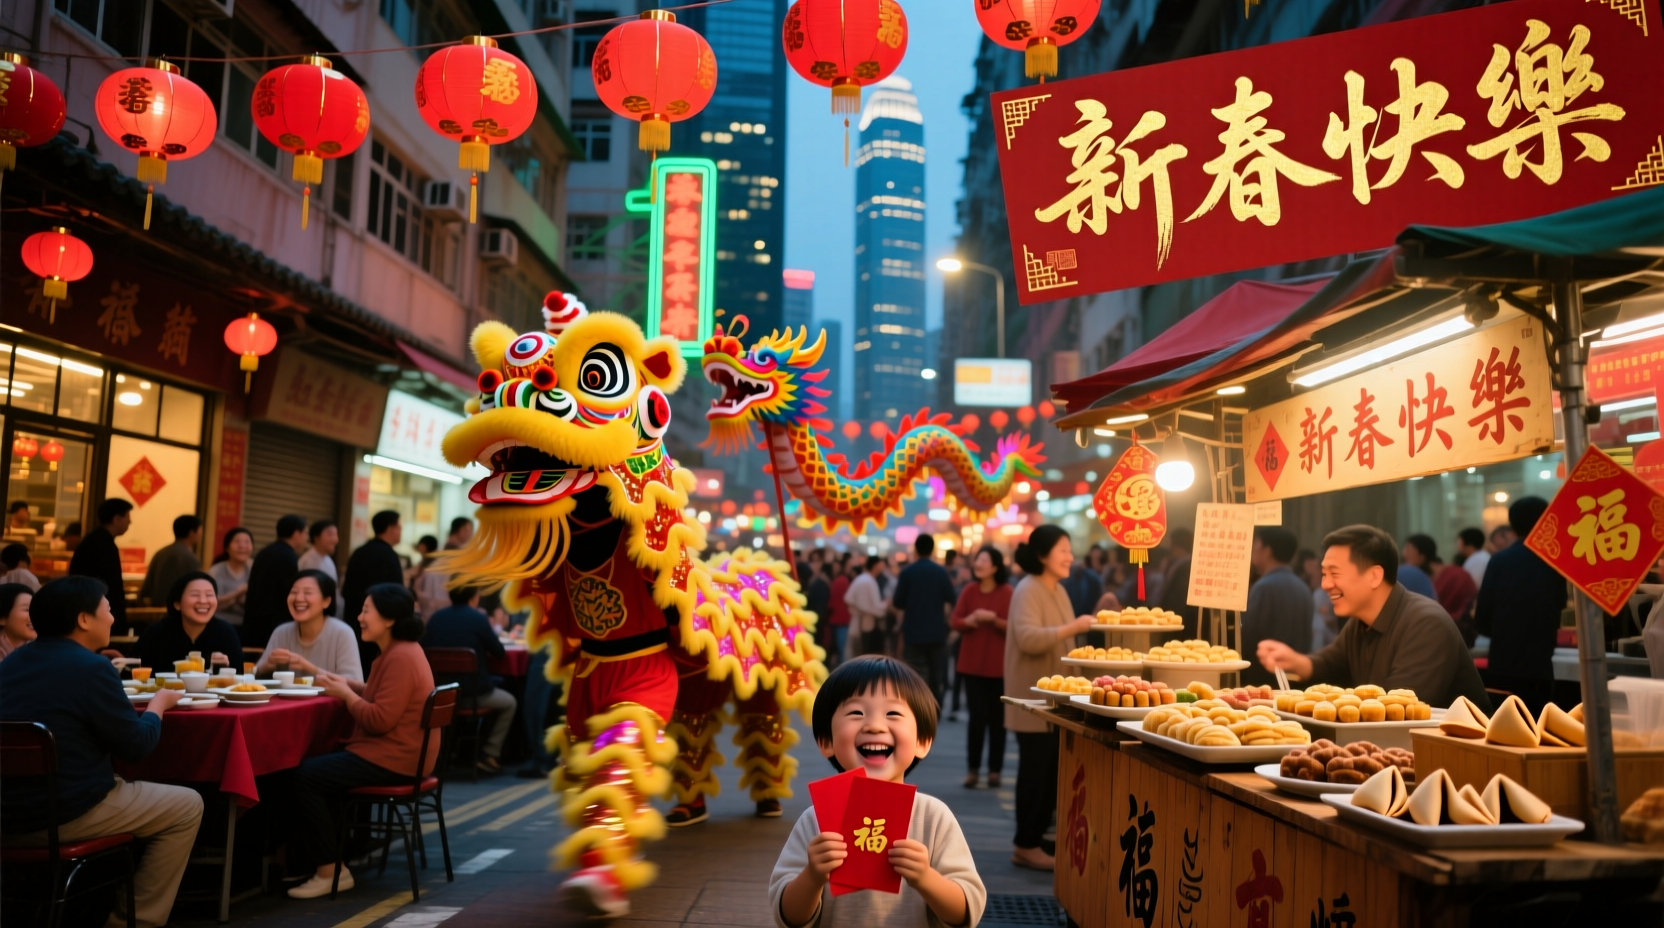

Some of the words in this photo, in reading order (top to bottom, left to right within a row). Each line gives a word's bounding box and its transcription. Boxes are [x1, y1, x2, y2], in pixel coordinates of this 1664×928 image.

[1034, 19, 1626, 271] 新春快樂
[1298, 346, 1531, 479] 新春快樂
[1567, 488, 1641, 565] 福
[853, 816, 888, 853] 福
[1119, 793, 1158, 928] 福
